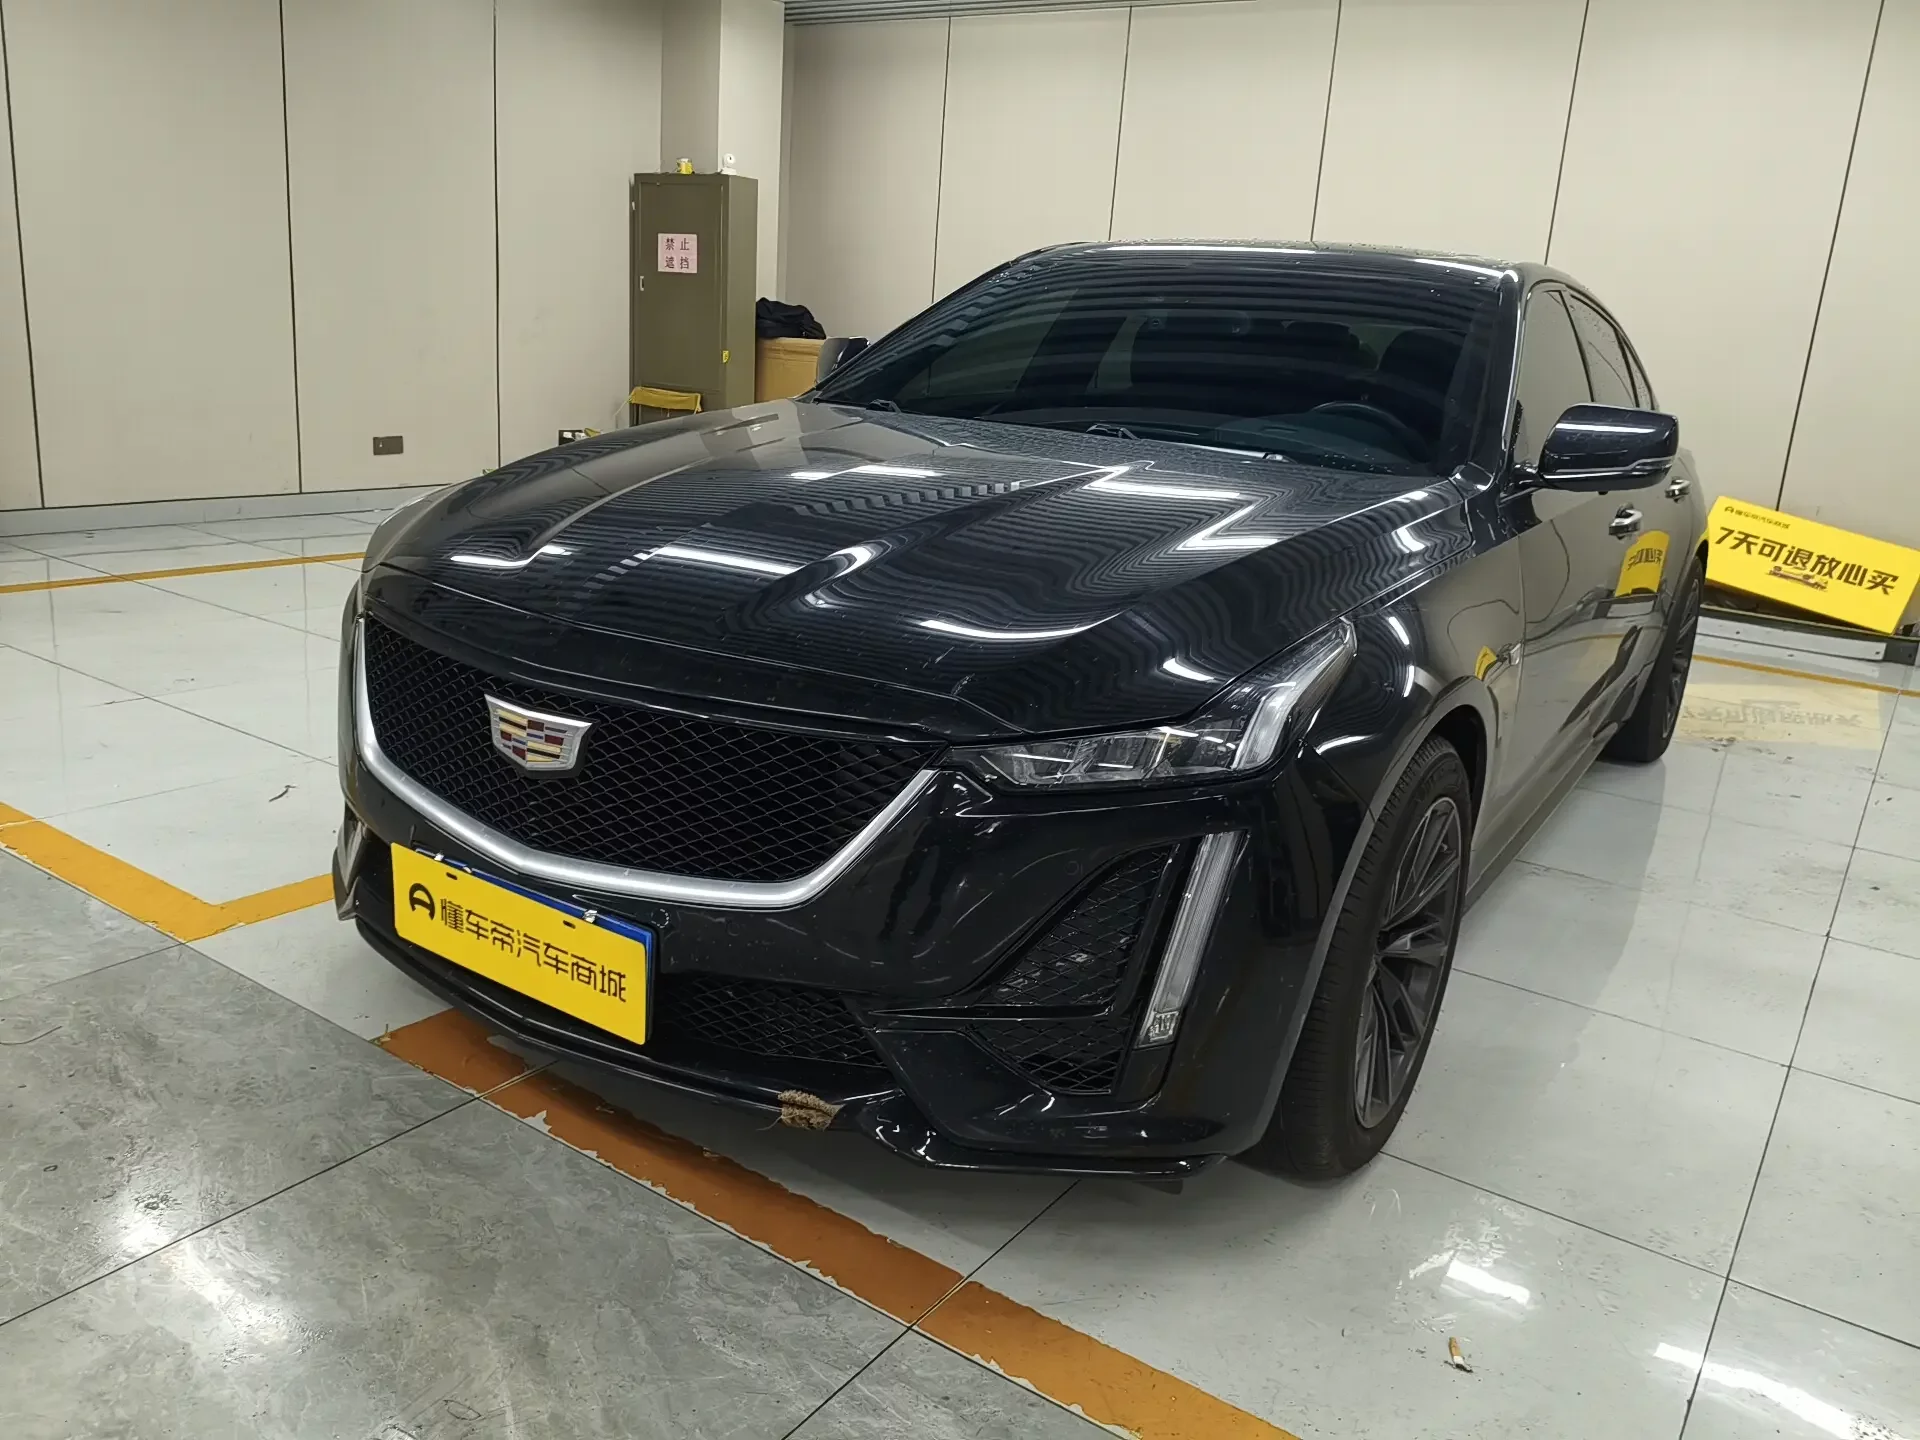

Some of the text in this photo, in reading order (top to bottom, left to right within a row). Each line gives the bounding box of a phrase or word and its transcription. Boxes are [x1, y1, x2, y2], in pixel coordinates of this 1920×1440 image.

[665, 237, 690, 251] 禁止
[665, 256, 690, 270] 遮挡
[1714, 526, 1900, 596] 7天可退放心买
[440, 898, 627, 1002] 懂车帝汽车商城
